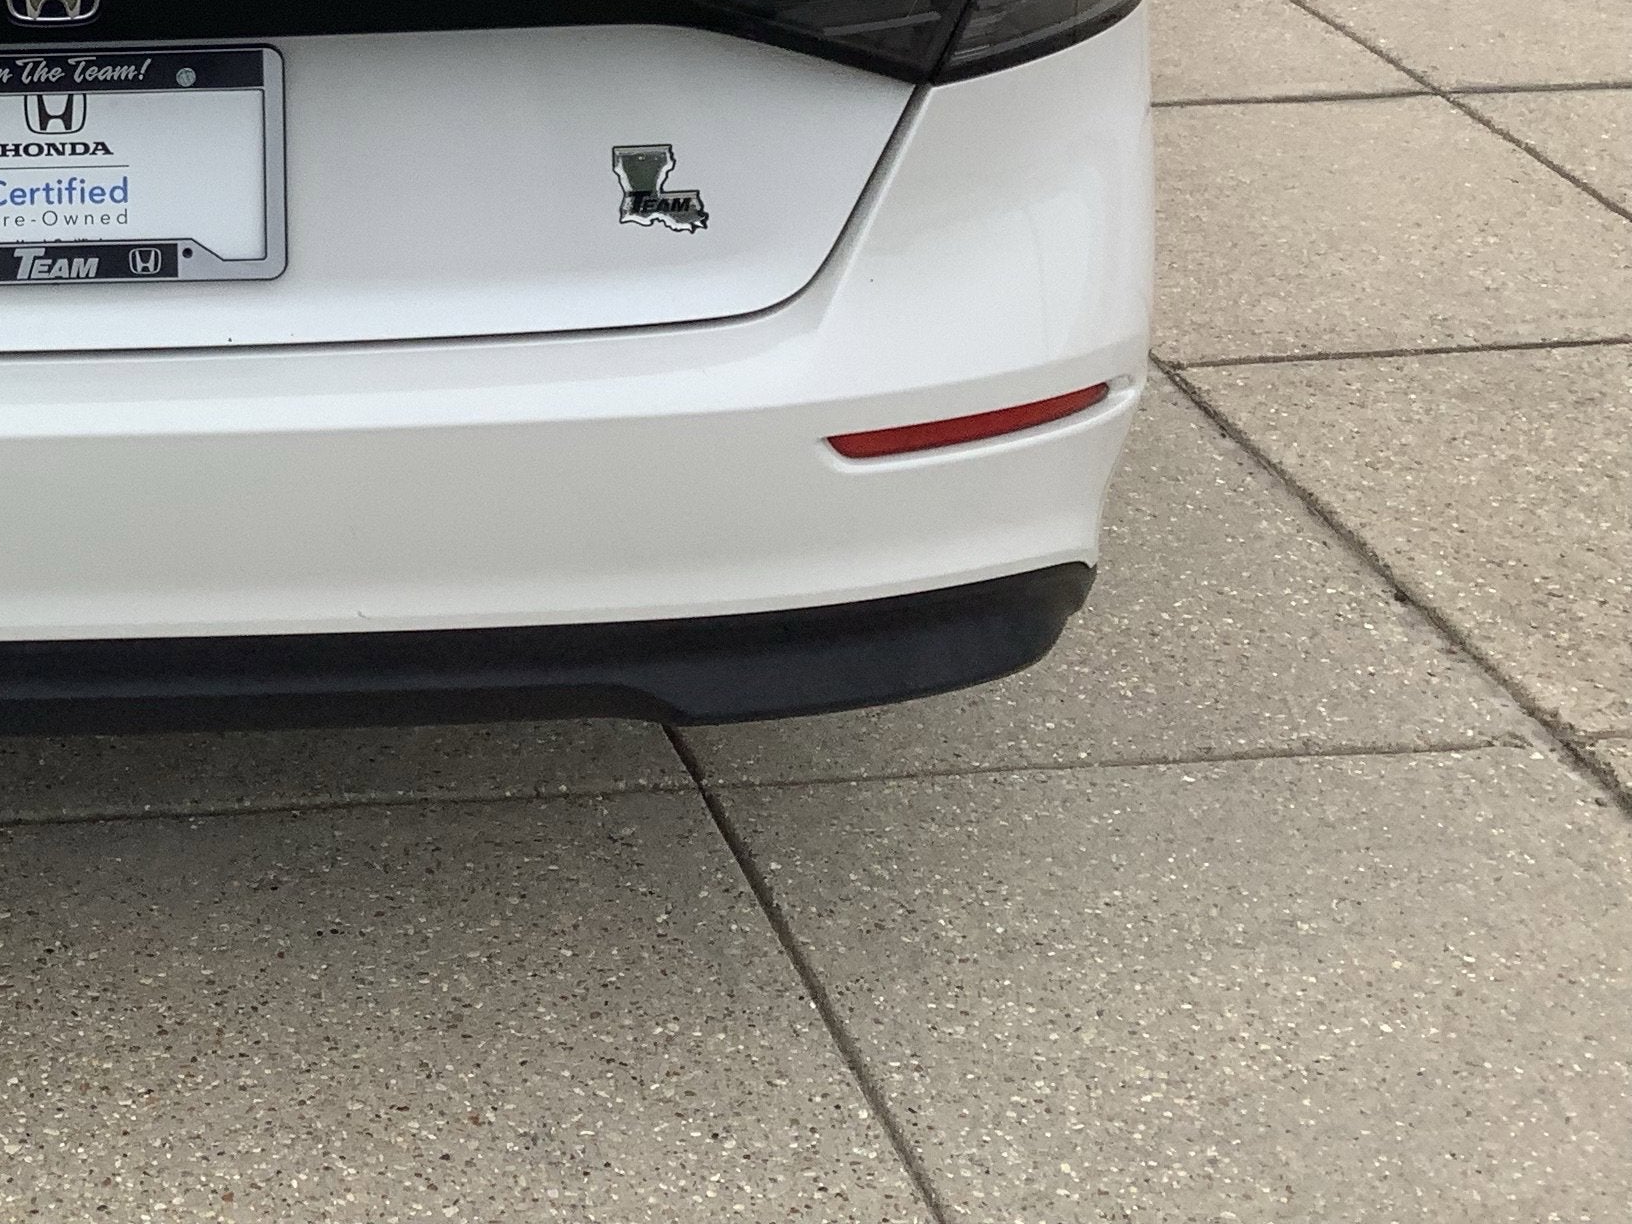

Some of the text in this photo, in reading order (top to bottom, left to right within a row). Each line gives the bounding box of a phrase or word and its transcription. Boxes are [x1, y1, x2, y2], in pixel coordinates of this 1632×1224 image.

[16, 57, 65, 84] The
[68, 56, 152, 84] Team!
[627, 190, 692, 214] TEAM
[14, 247, 100, 280] TEAM
